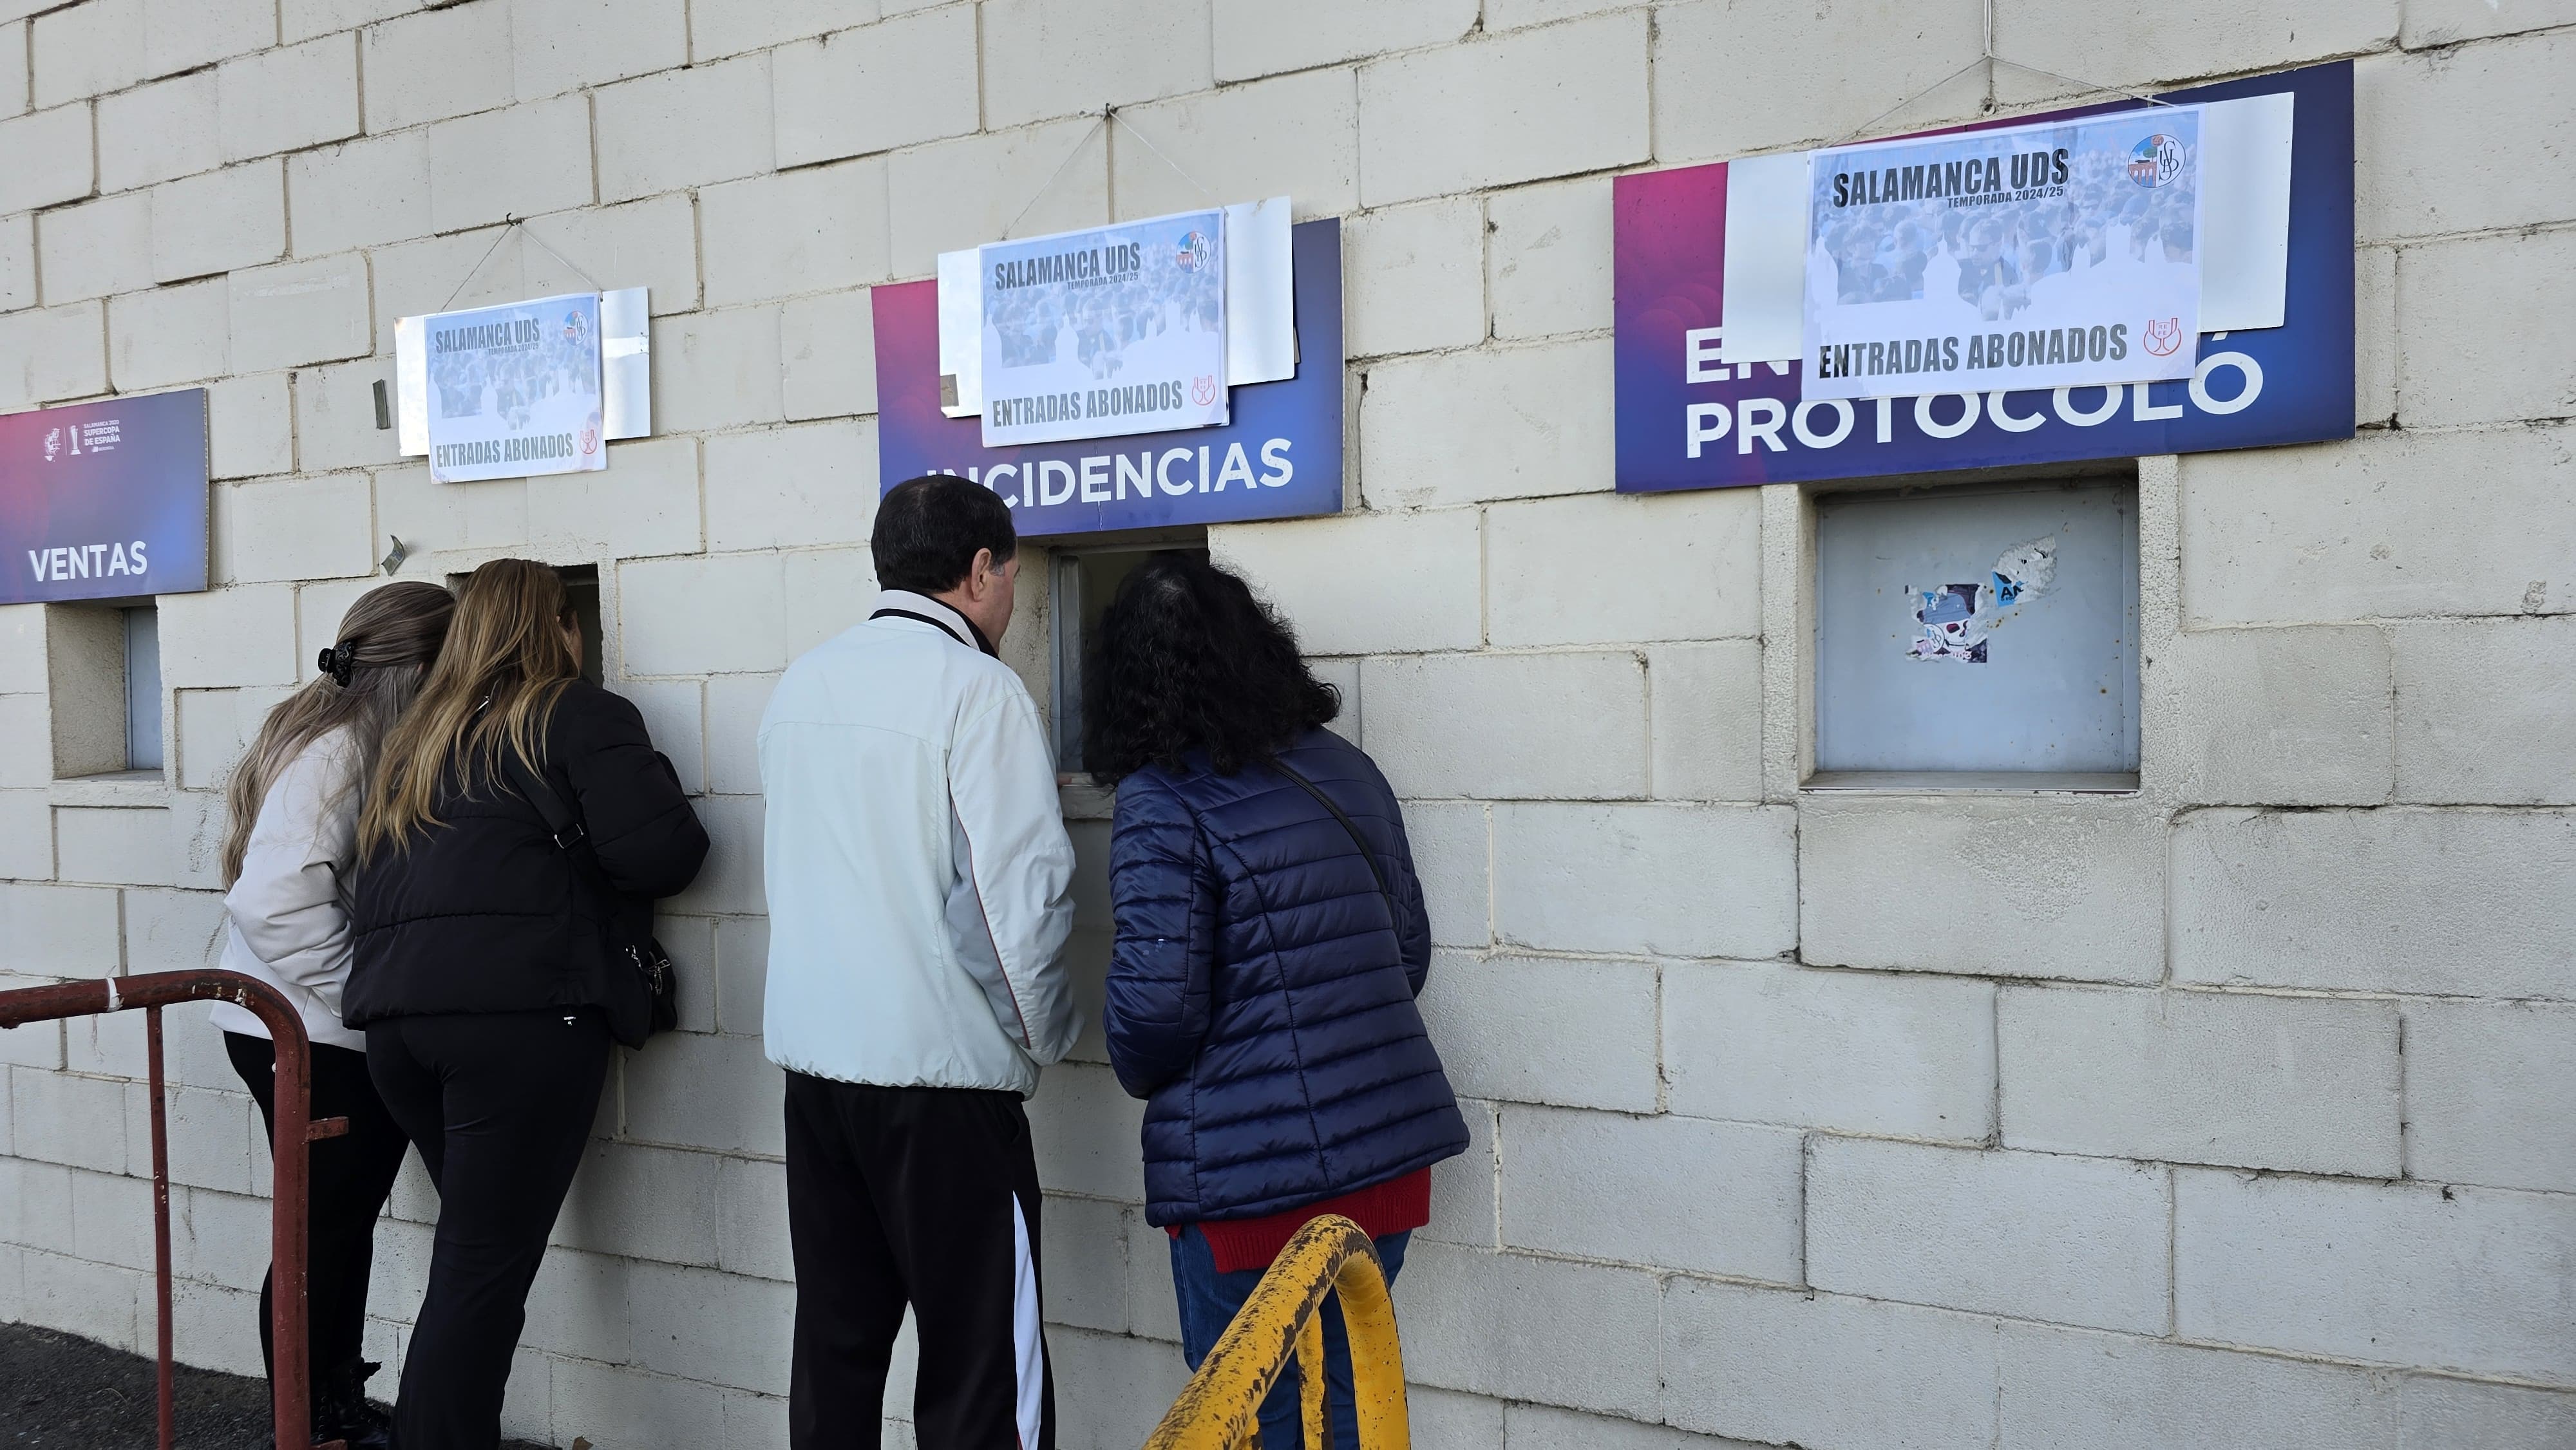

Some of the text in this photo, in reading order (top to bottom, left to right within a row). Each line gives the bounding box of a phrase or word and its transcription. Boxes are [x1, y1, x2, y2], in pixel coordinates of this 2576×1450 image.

[1833, 148, 2069, 208] SALAMANCA UDS
[1947, 185, 2064, 209] TEMPORADA 2024/25
[995, 242, 1141, 290] SALAMANCA UDS
[1067, 272, 1139, 290] TEMPORADA 2024/25
[436, 317, 540, 353] SALAMANCA UDS
[1819, 323, 2128, 379] ENTRADAS ABONADOS
[992, 380, 1183, 428] ENTRADAS ABONADOS
[84, 426, 120, 437] SUPERCOPA
[95, 434, 120, 444] ESPAÑA
[436, 433, 573, 468] ENTRADAS ABONADOS
[927, 438, 1293, 507] CIDENCIAS
[28, 541, 147, 581] VENTAS
